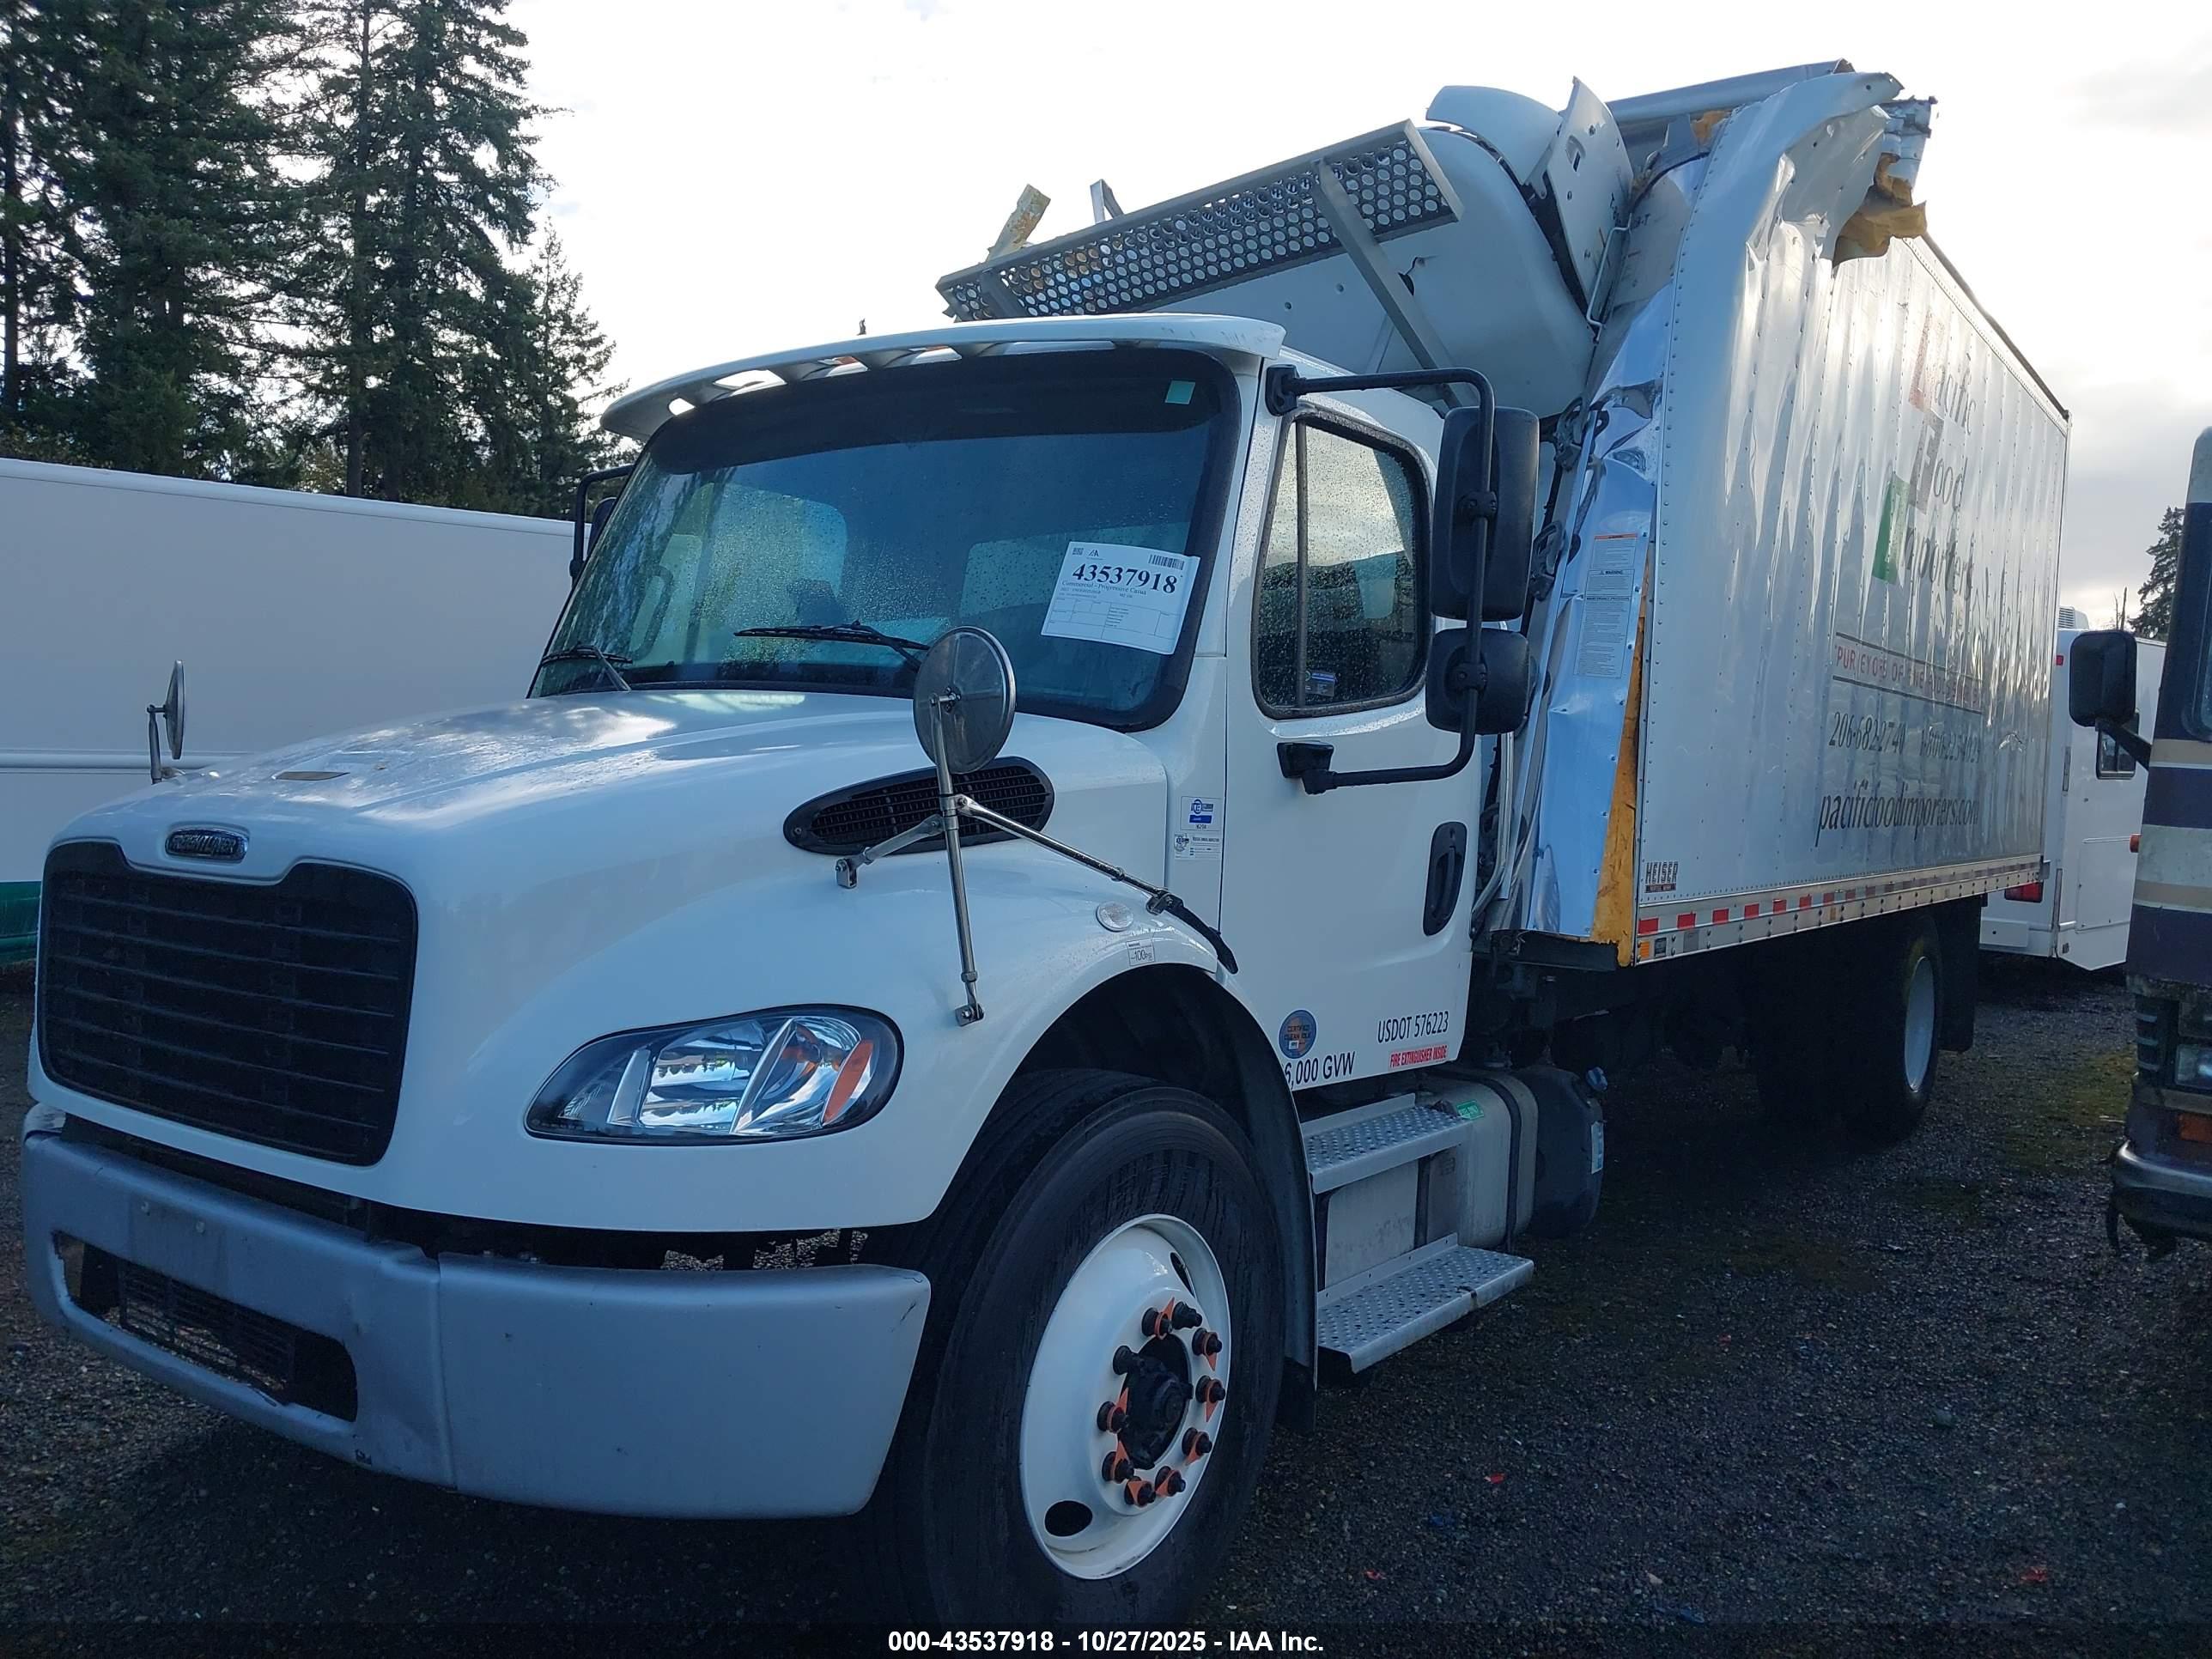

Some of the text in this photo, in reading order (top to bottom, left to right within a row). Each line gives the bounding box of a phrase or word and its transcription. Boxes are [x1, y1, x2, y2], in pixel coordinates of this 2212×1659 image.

[1072, 563, 1178, 594] 43537918
[1644, 861, 1678, 884] HEISER
[1376, 1010, 1449, 1044] USDOT 576223
[1322, 1050, 1356, 1079] GVW
[1389, 1043, 1448, 1068] FIRE EXTINGUISHER INSIDE
